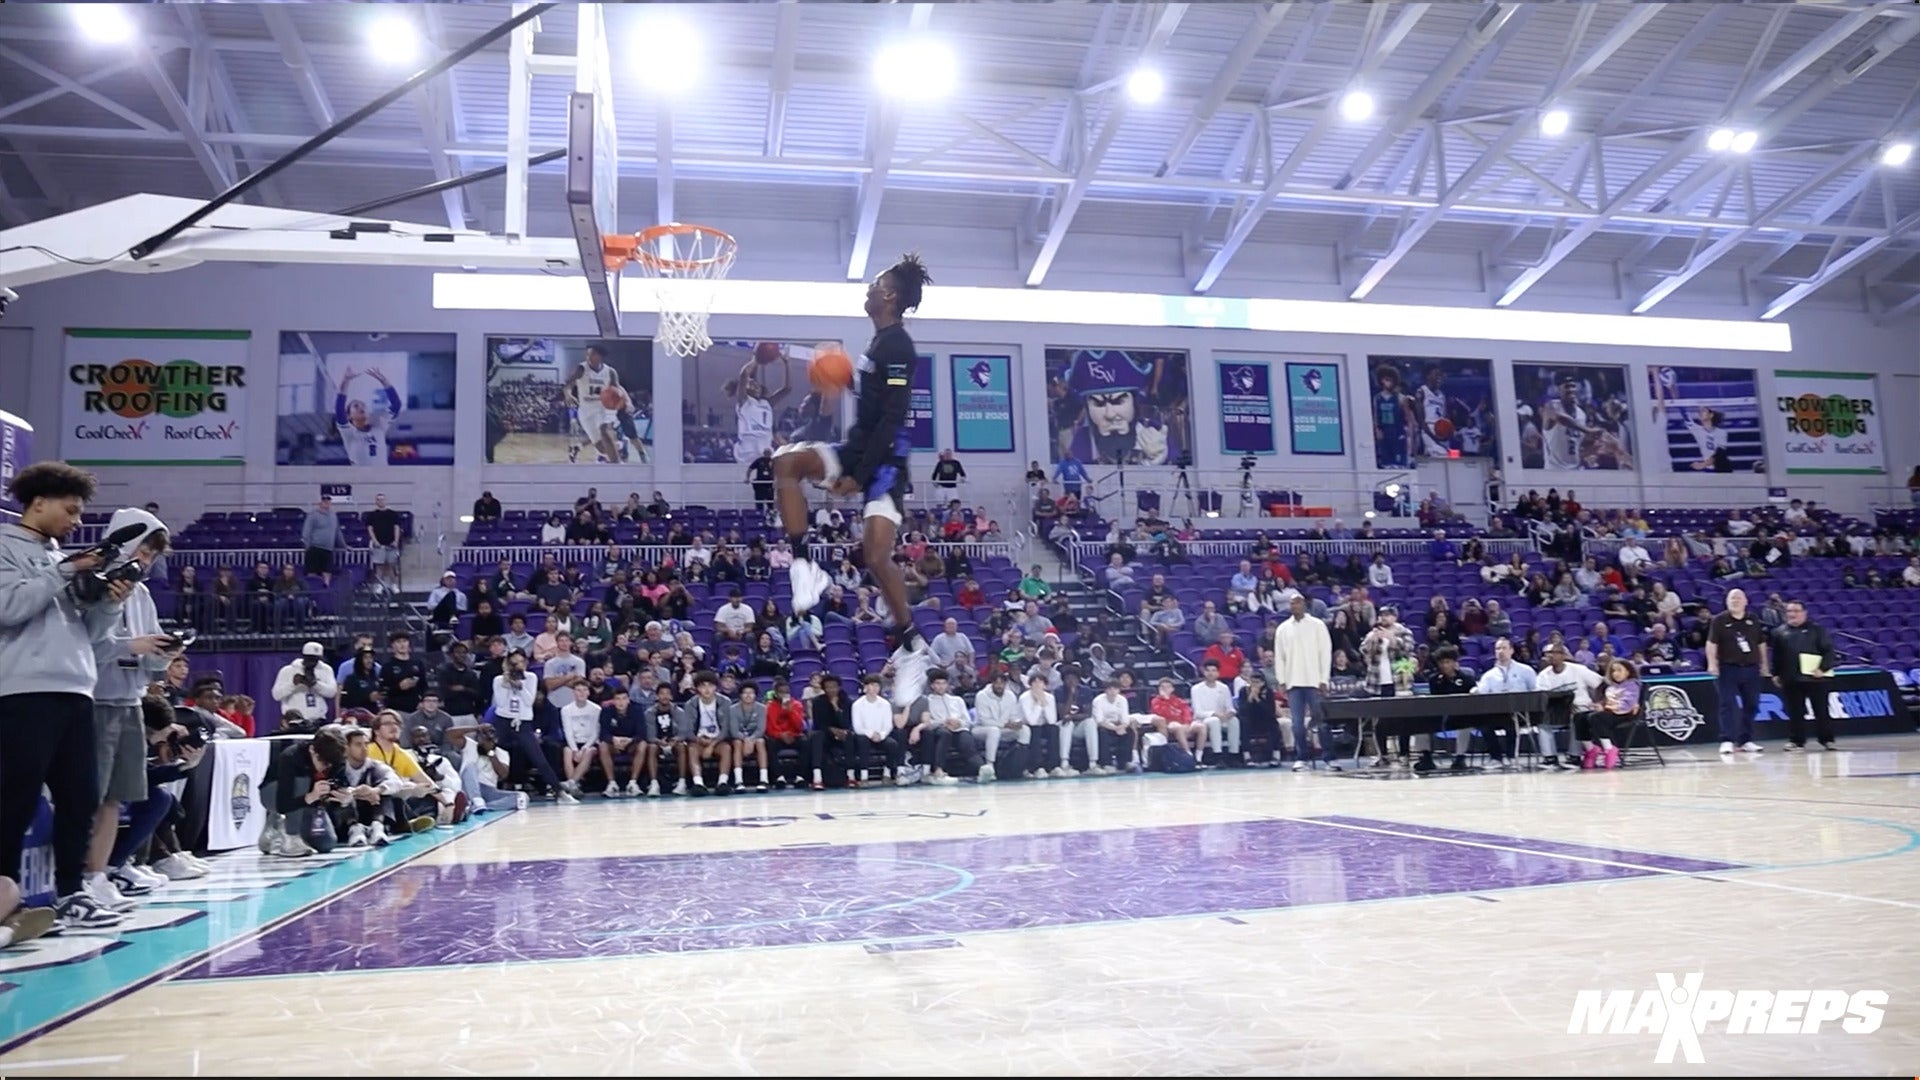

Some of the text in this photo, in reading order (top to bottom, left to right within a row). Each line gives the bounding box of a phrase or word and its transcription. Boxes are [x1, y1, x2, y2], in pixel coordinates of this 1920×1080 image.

[69, 363, 246, 388] CROWTHER
[1087, 361, 1116, 383] FSW
[84, 390, 227, 415] ROOFING
[1777, 396, 1875, 416] CROWTHER
[984, 411, 1010, 420] 2020
[1786, 417, 1867, 435] ROOFING
